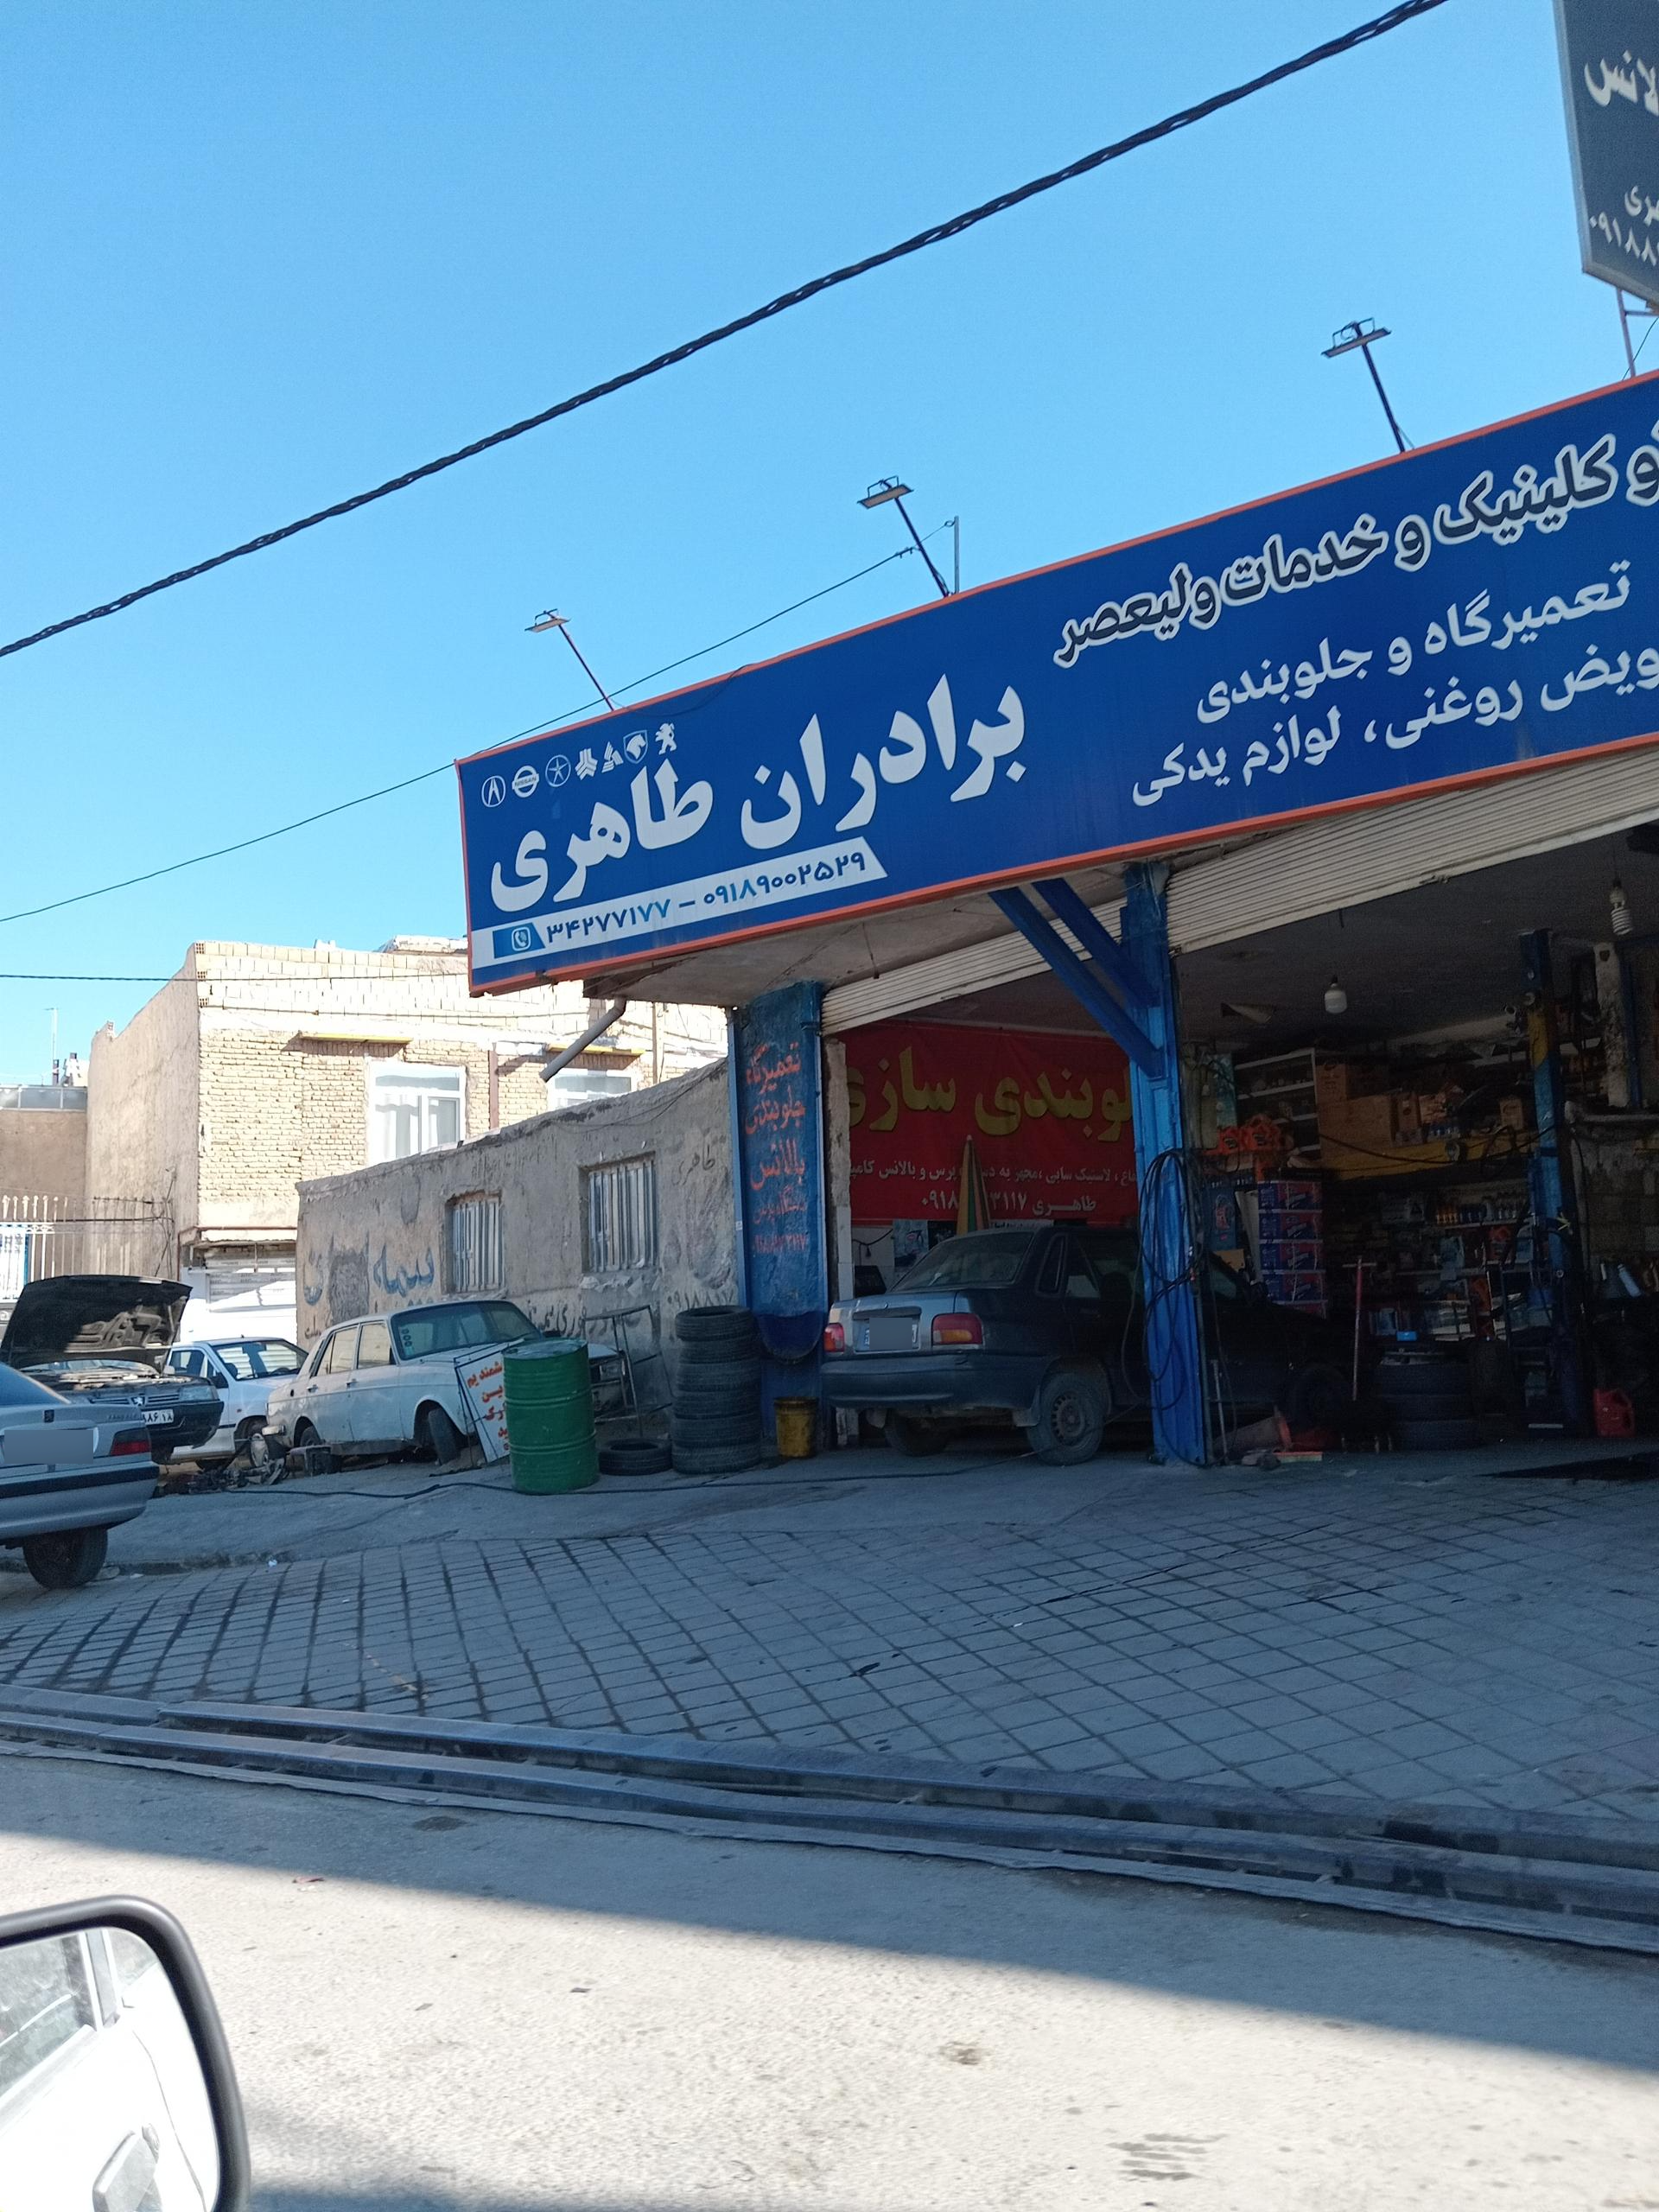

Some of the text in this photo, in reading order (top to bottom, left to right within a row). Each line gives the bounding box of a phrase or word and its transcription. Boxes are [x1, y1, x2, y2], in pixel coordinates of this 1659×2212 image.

[1433, 433, 1619, 548] کلینیک
[1221, 514, 1390, 607] خدمات
[1394, 514, 1432, 572] و
[1052, 563, 1223, 669] ولیعصر
[1196, 559, 1632, 723] تعمیرگاه و جلوبندی
[1131, 743, 1228, 807] یدکی
[1243, 705, 1341, 785] لوازم
[490, 674, 1027, 912] برادران طاهری
[546, 899, 671, 944] ۳۴۲۷۷۱۷۷
[703, 851, 866, 906] ۰۹۱۸۹۰۰۲۵۲۹
[746, 1041, 802, 1096] تعمیرگاه
